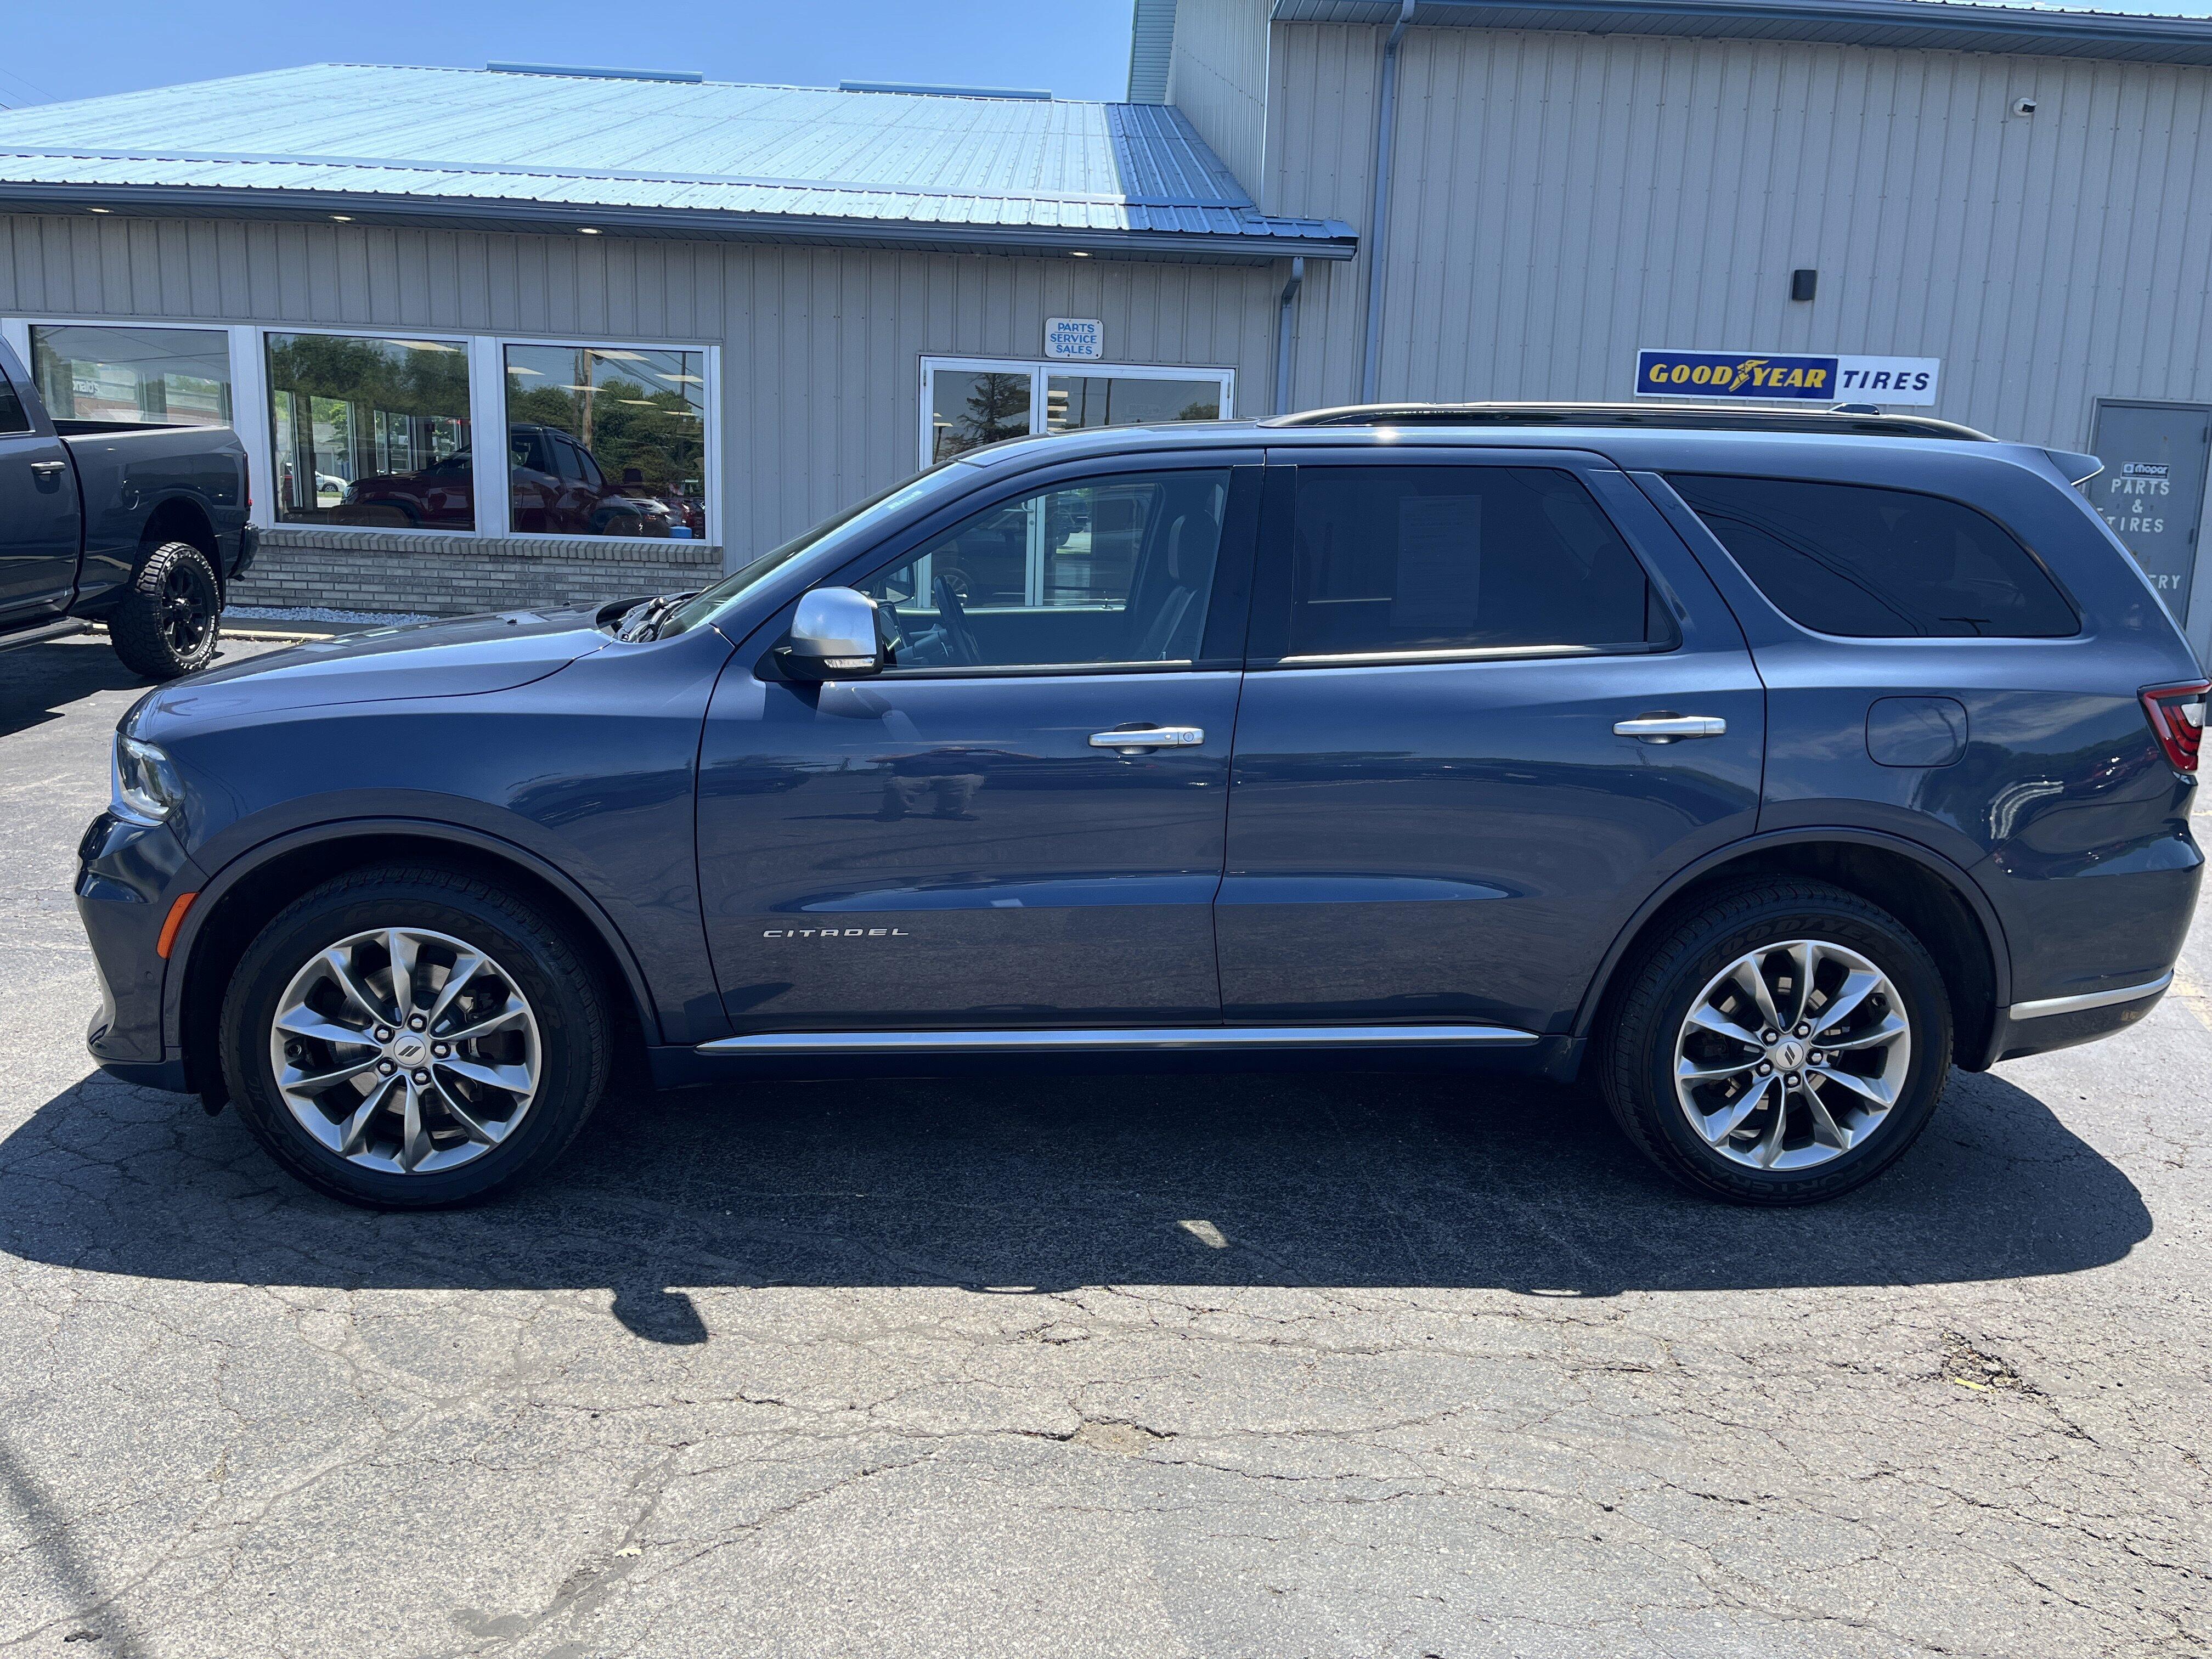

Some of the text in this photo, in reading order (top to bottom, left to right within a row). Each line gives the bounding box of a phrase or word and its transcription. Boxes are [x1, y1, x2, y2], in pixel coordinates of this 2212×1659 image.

[1058, 323, 1094, 332] PARTS
[1050, 333, 1097, 344] SERVICE
[1056, 345, 1092, 354] SALES
[1649, 363, 1931, 391] GOODYEAR TIRES
[2111, 478, 2170, 495] PARTS
[2132, 499, 2143, 514] &
[763, 928, 909, 938] CITADEL
